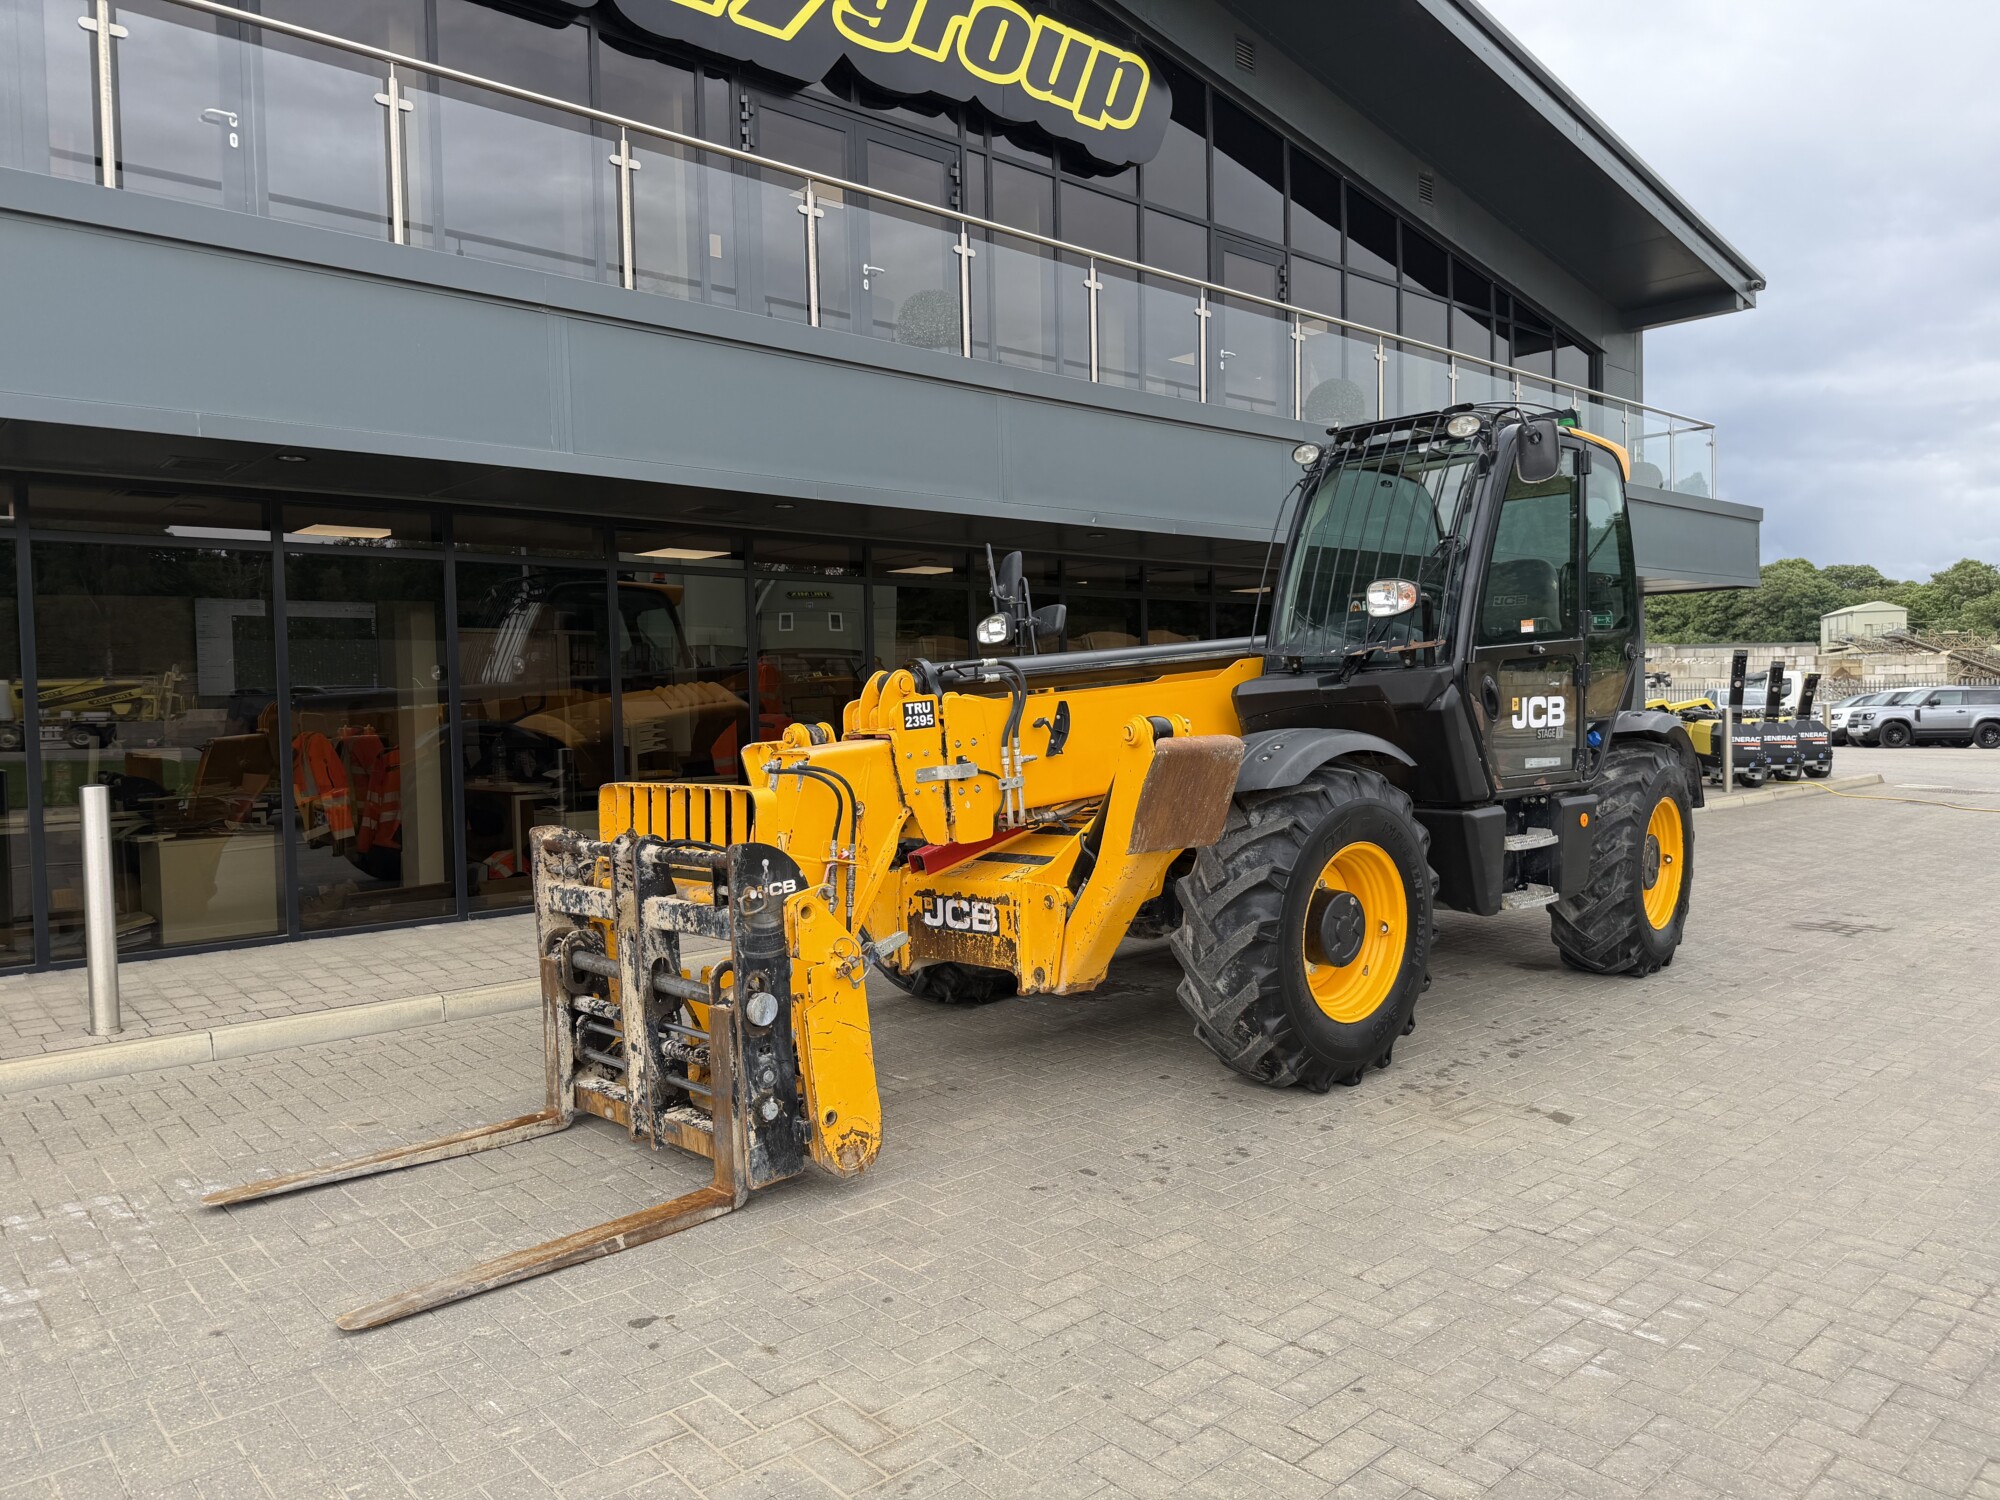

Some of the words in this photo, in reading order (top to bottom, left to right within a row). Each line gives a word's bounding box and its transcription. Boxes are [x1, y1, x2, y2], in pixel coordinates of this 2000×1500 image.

[905, 702, 931, 715] TRU
[1511, 696, 1566, 729] JCB
[905, 714, 934, 728] 2395
[1537, 728, 1556, 739] STAGE
[923, 896, 998, 933] JCB
